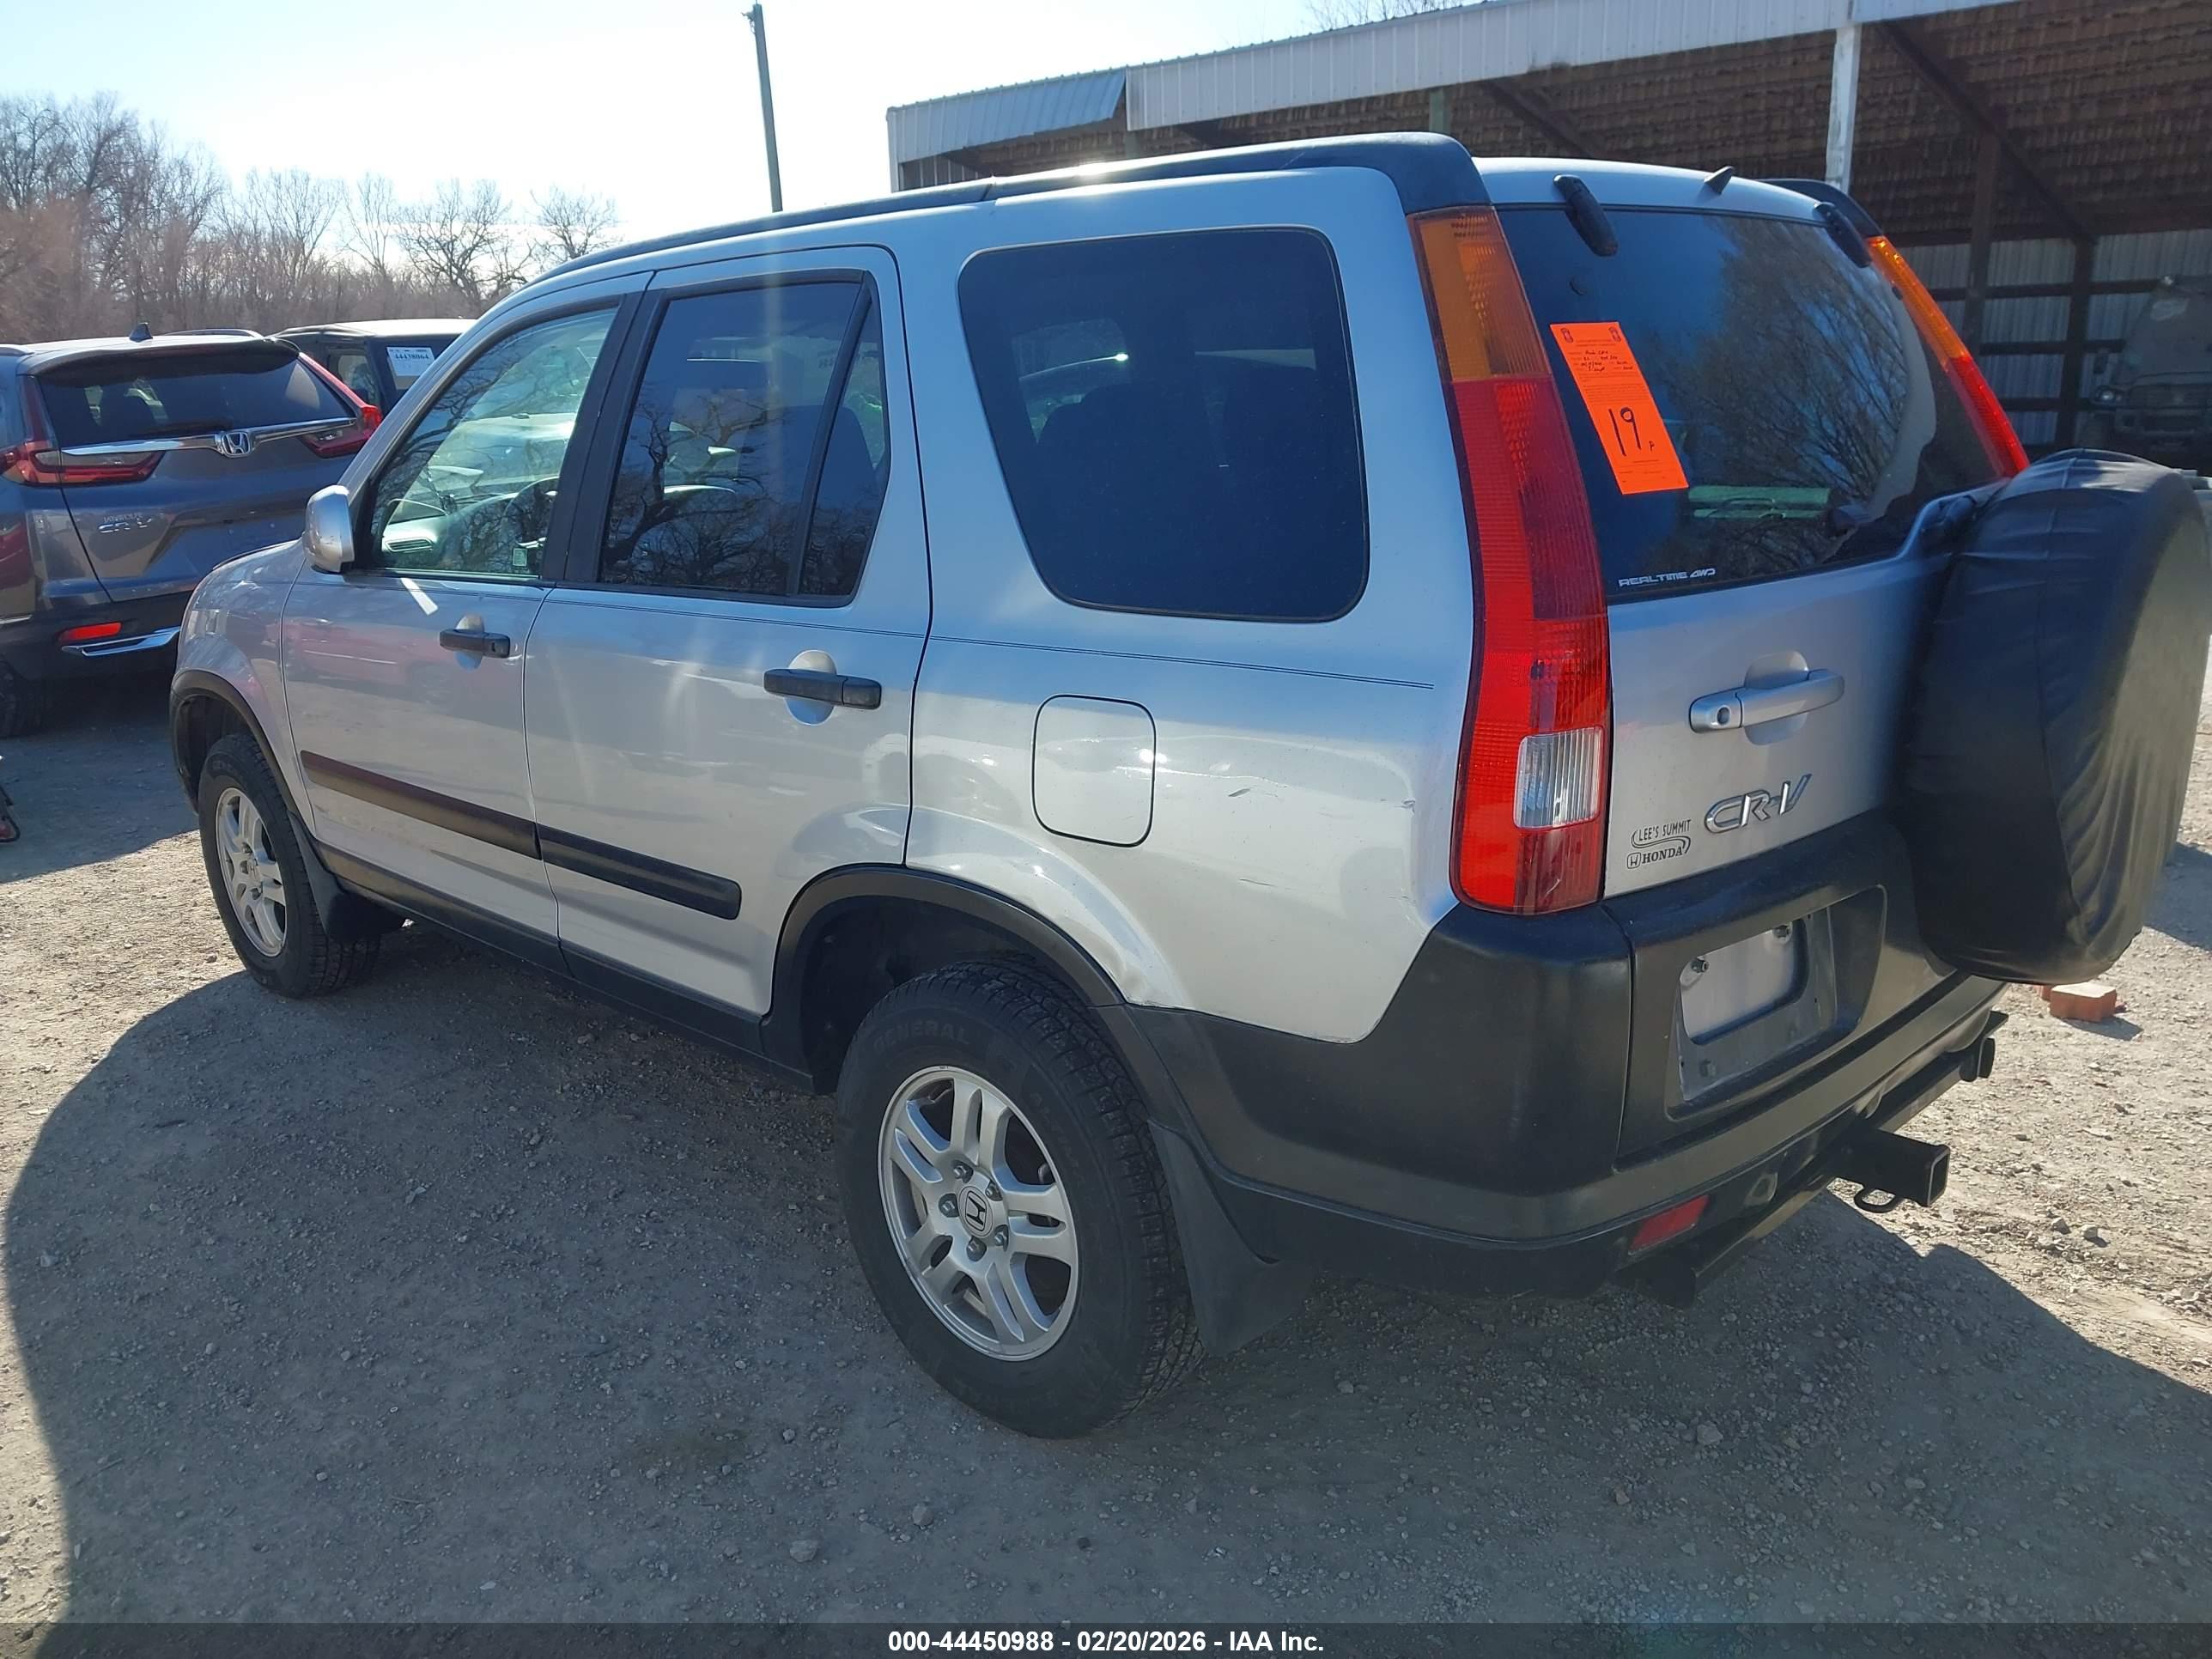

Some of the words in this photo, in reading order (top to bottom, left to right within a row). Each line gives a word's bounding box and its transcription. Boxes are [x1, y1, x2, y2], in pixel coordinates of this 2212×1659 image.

[1607, 407, 1642, 457] 19
[1618, 571, 1688, 587] REALTIME
[1704, 773, 1814, 834] CR-V
[1638, 825, 1659, 842] LEE'S
[1662, 819, 1692, 836] SUMMIT
[1642, 846, 1683, 864] HONDA
